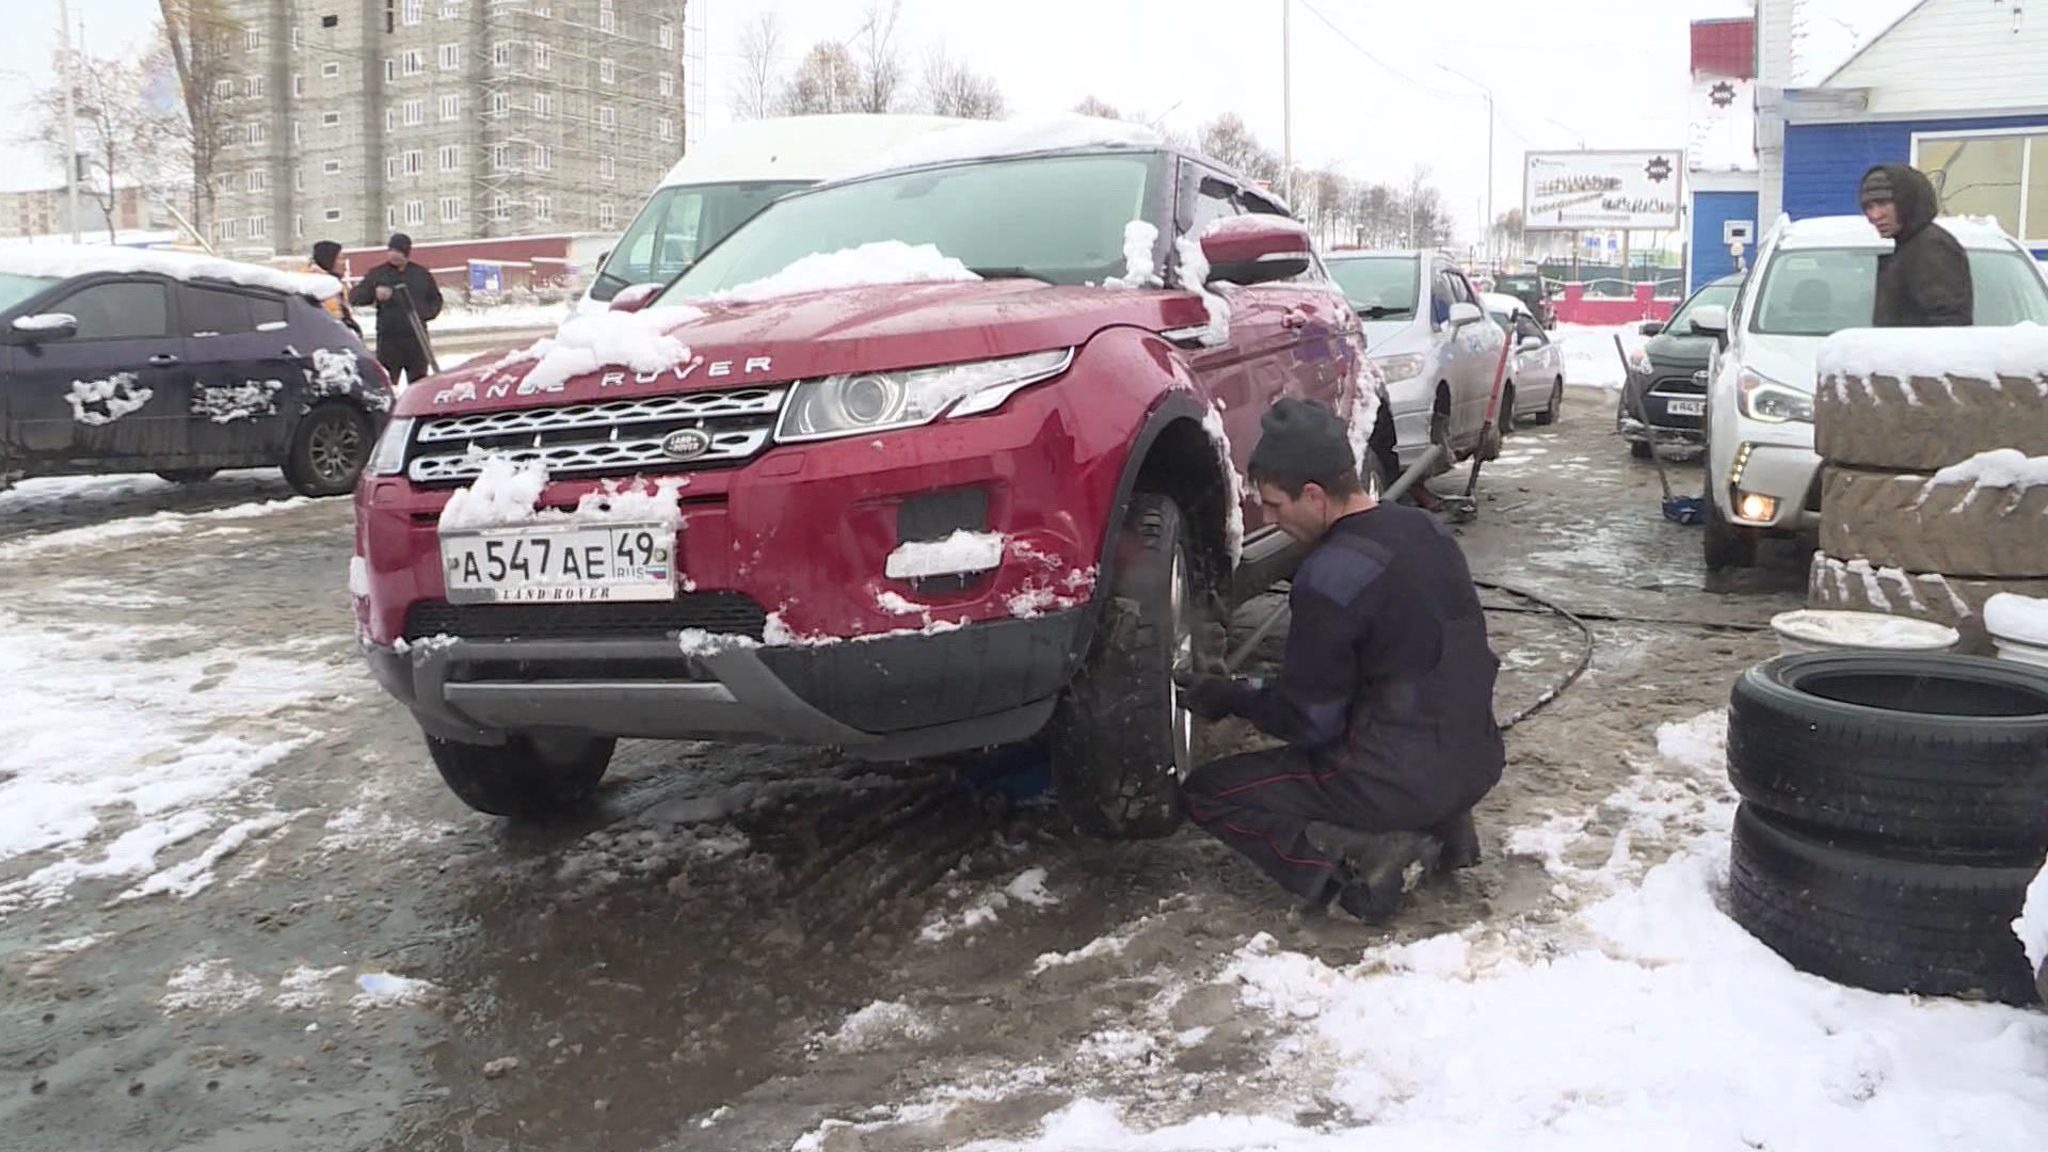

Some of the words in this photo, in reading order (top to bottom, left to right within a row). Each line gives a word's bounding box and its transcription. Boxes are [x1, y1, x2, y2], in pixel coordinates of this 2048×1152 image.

[433, 378, 564, 405] RANG
[601, 356, 772, 387] ROVER
[617, 531, 654, 566] 49
[617, 566, 645, 579] RUS
[503, 588, 546, 600] LAND
[554, 587, 611, 600] ROVER
